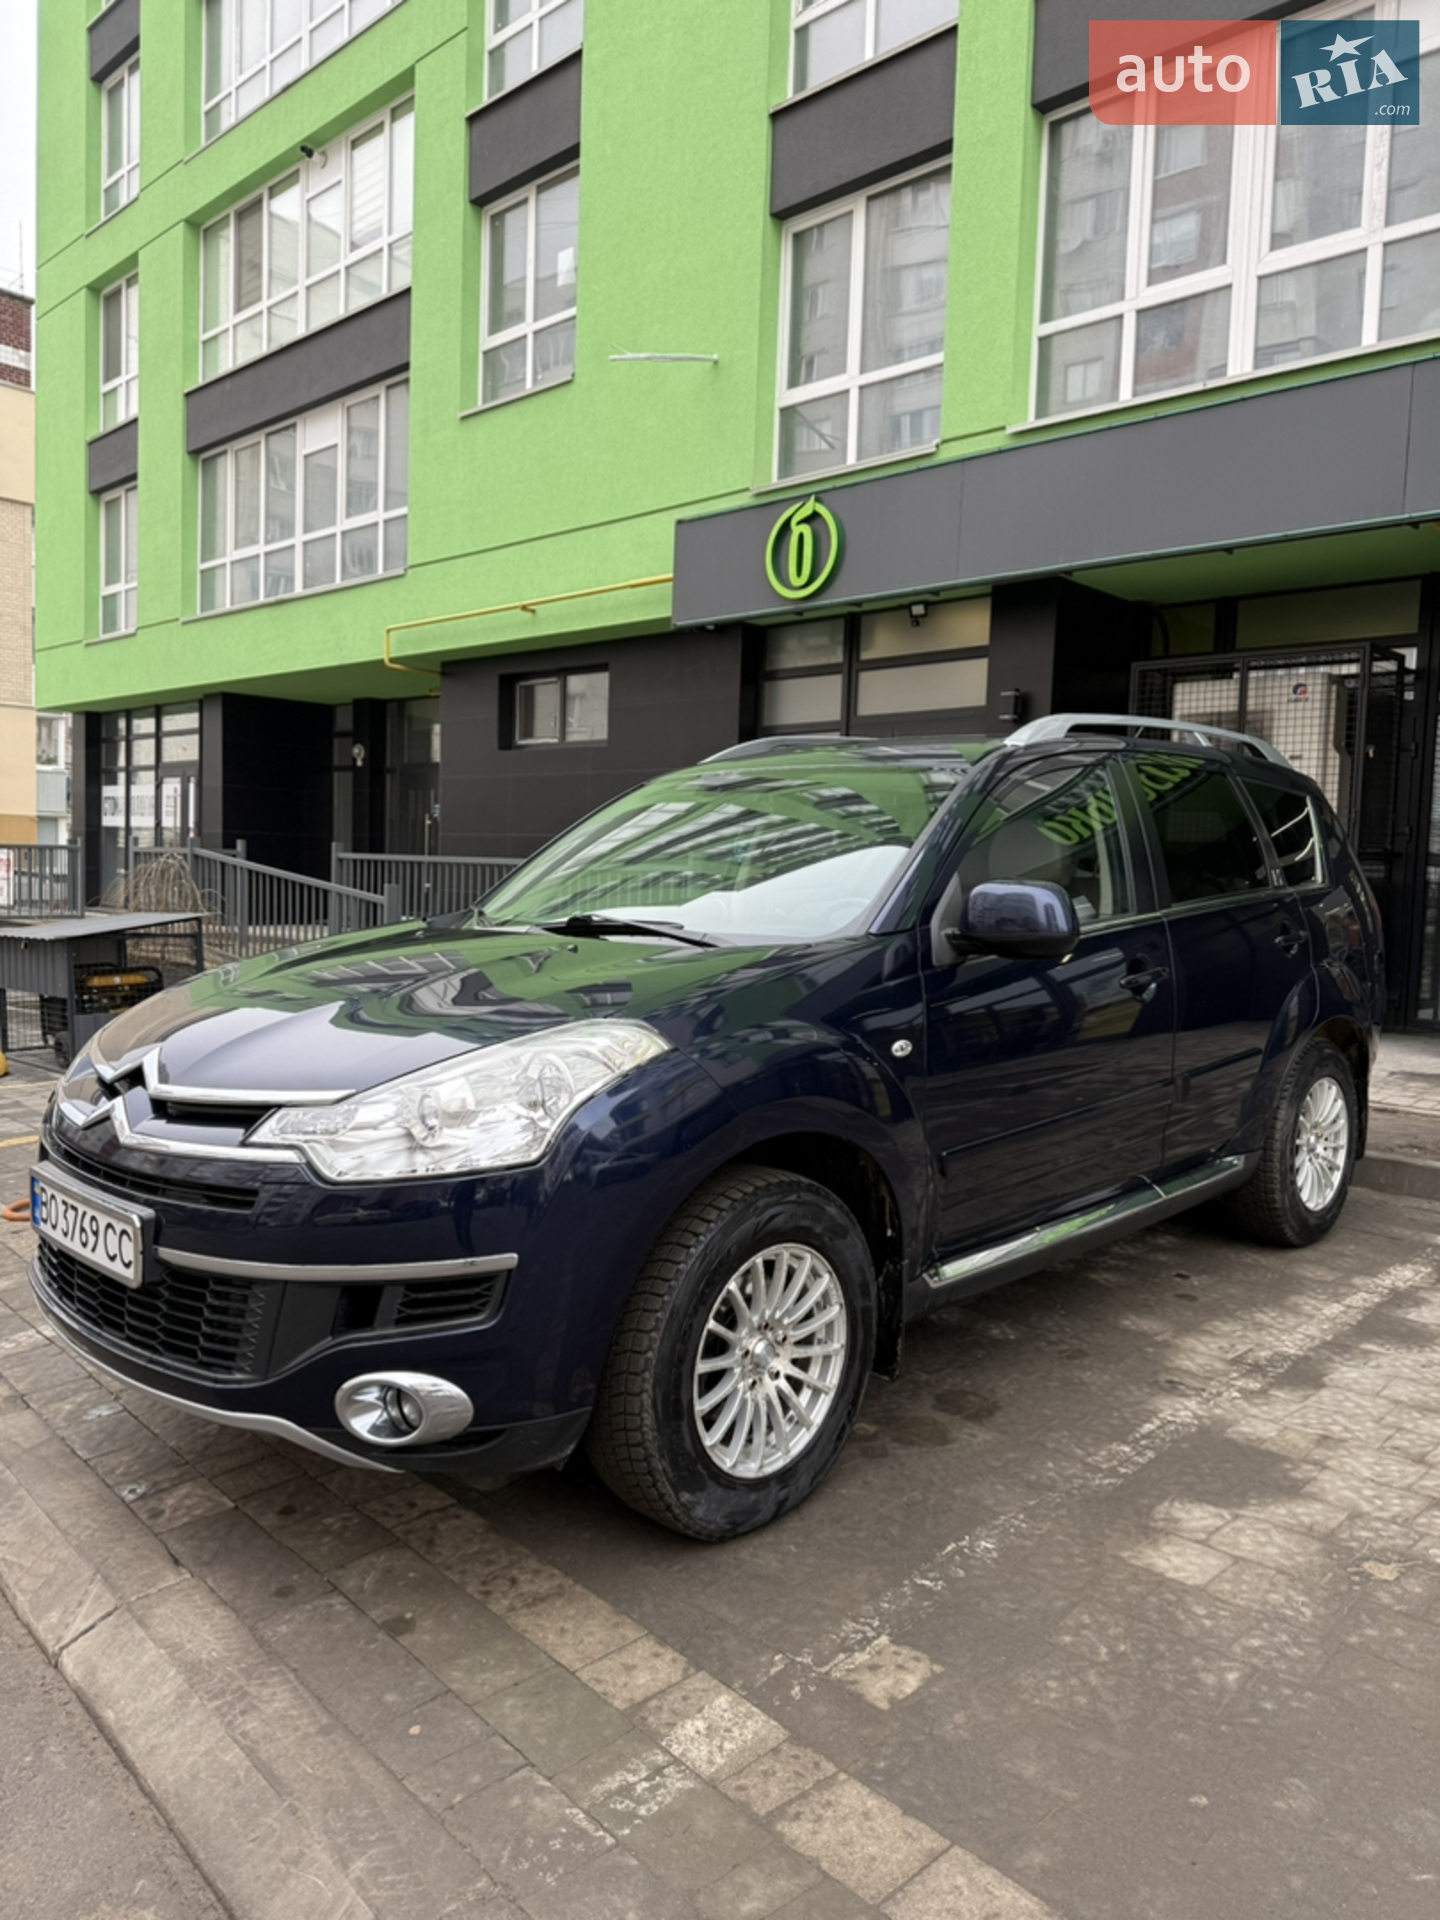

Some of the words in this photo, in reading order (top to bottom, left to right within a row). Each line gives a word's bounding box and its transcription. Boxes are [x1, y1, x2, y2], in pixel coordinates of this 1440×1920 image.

[40, 1187, 59, 1231] BO
[61, 1199, 100, 1254] 3769
[104, 1222, 133, 1269] CC
